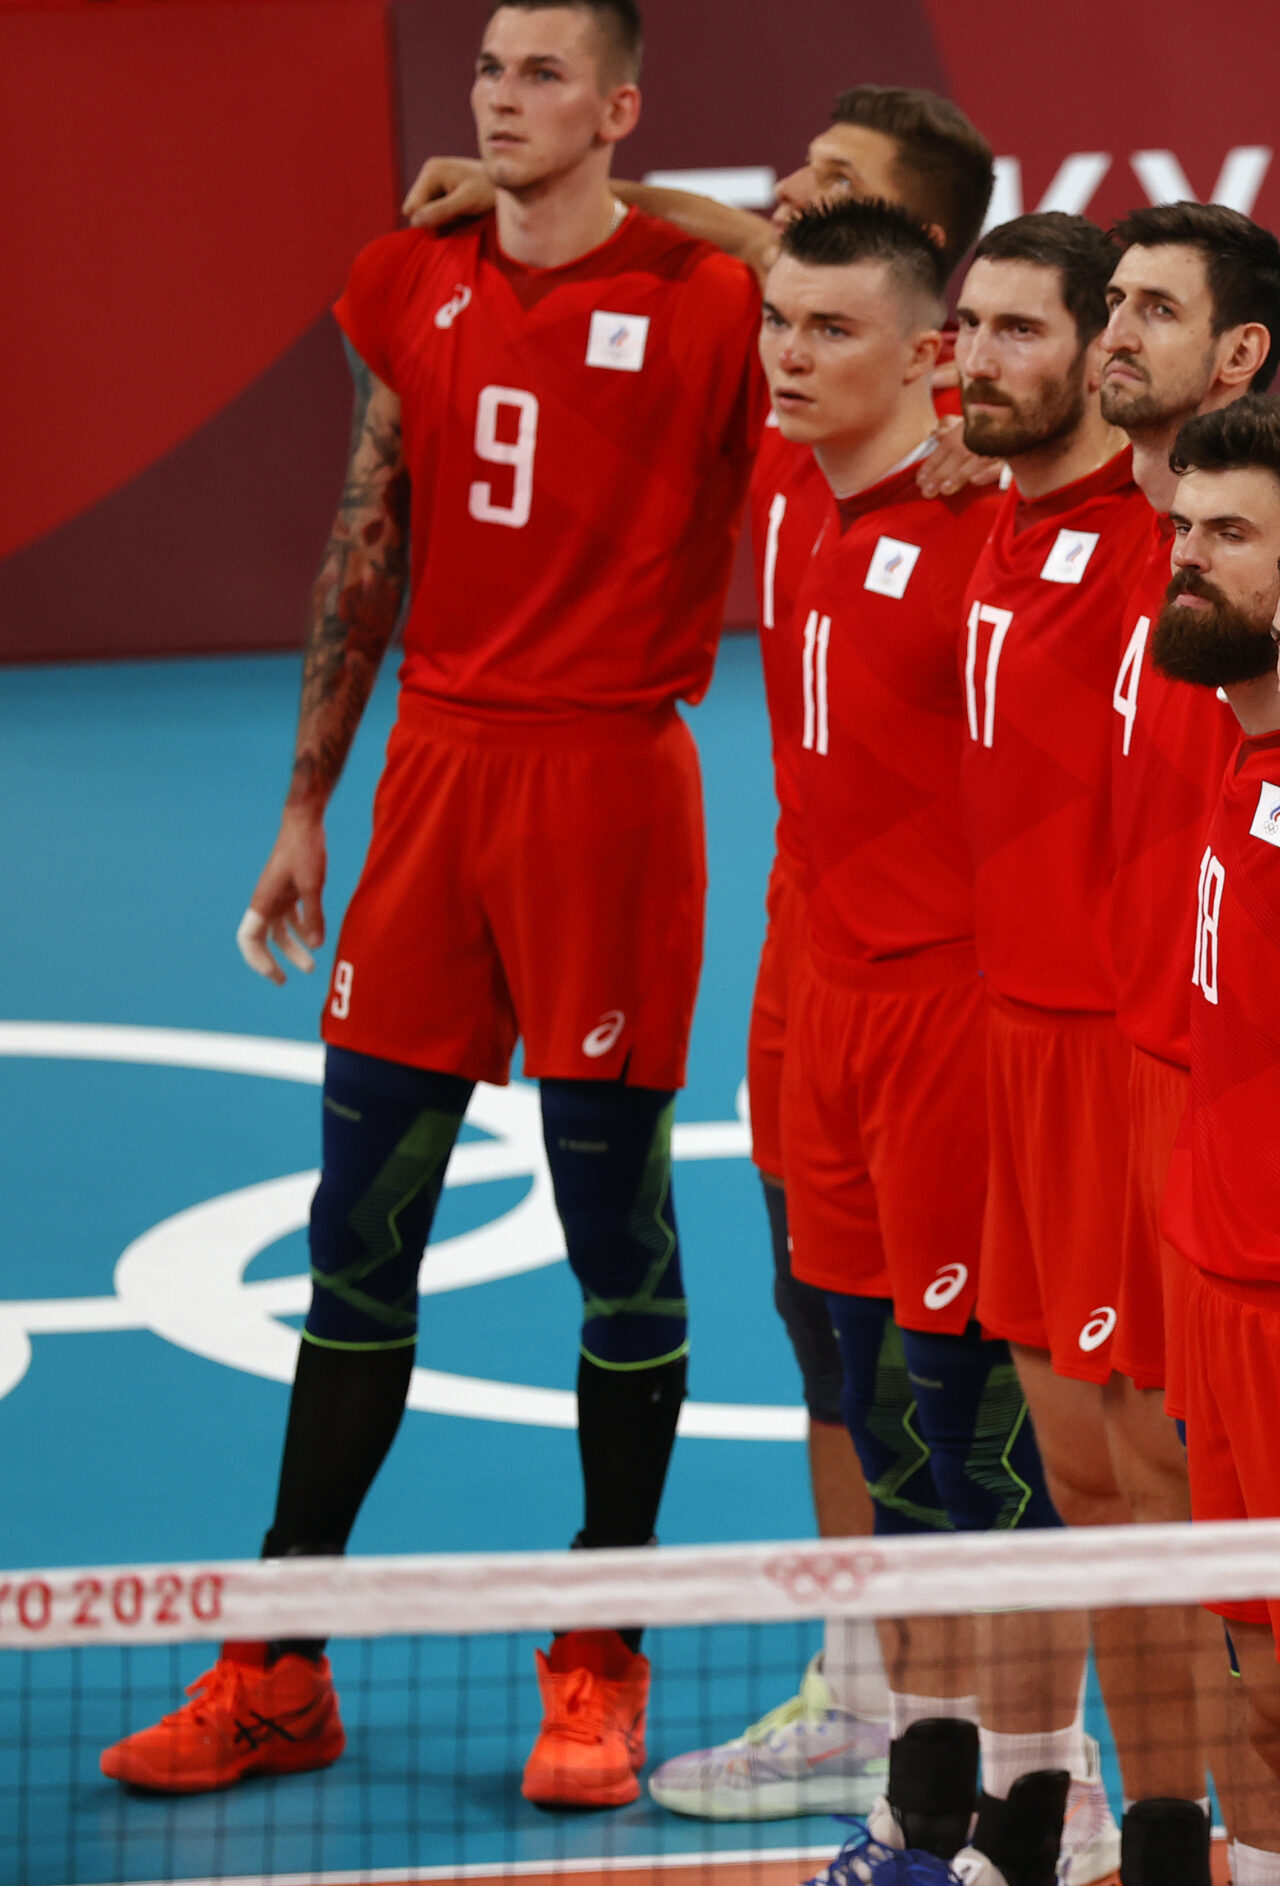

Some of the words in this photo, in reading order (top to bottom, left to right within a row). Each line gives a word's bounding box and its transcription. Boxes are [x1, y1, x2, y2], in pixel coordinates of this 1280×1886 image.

[469, 385, 540, 528] 9
[802, 609, 832, 756] 11
[965, 599, 1014, 749] 17
[1112, 615, 1151, 757] 4
[330, 960, 354, 1019] 9
[1191, 844, 1226, 1005] 18
[72, 1573, 225, 1627] 2020
